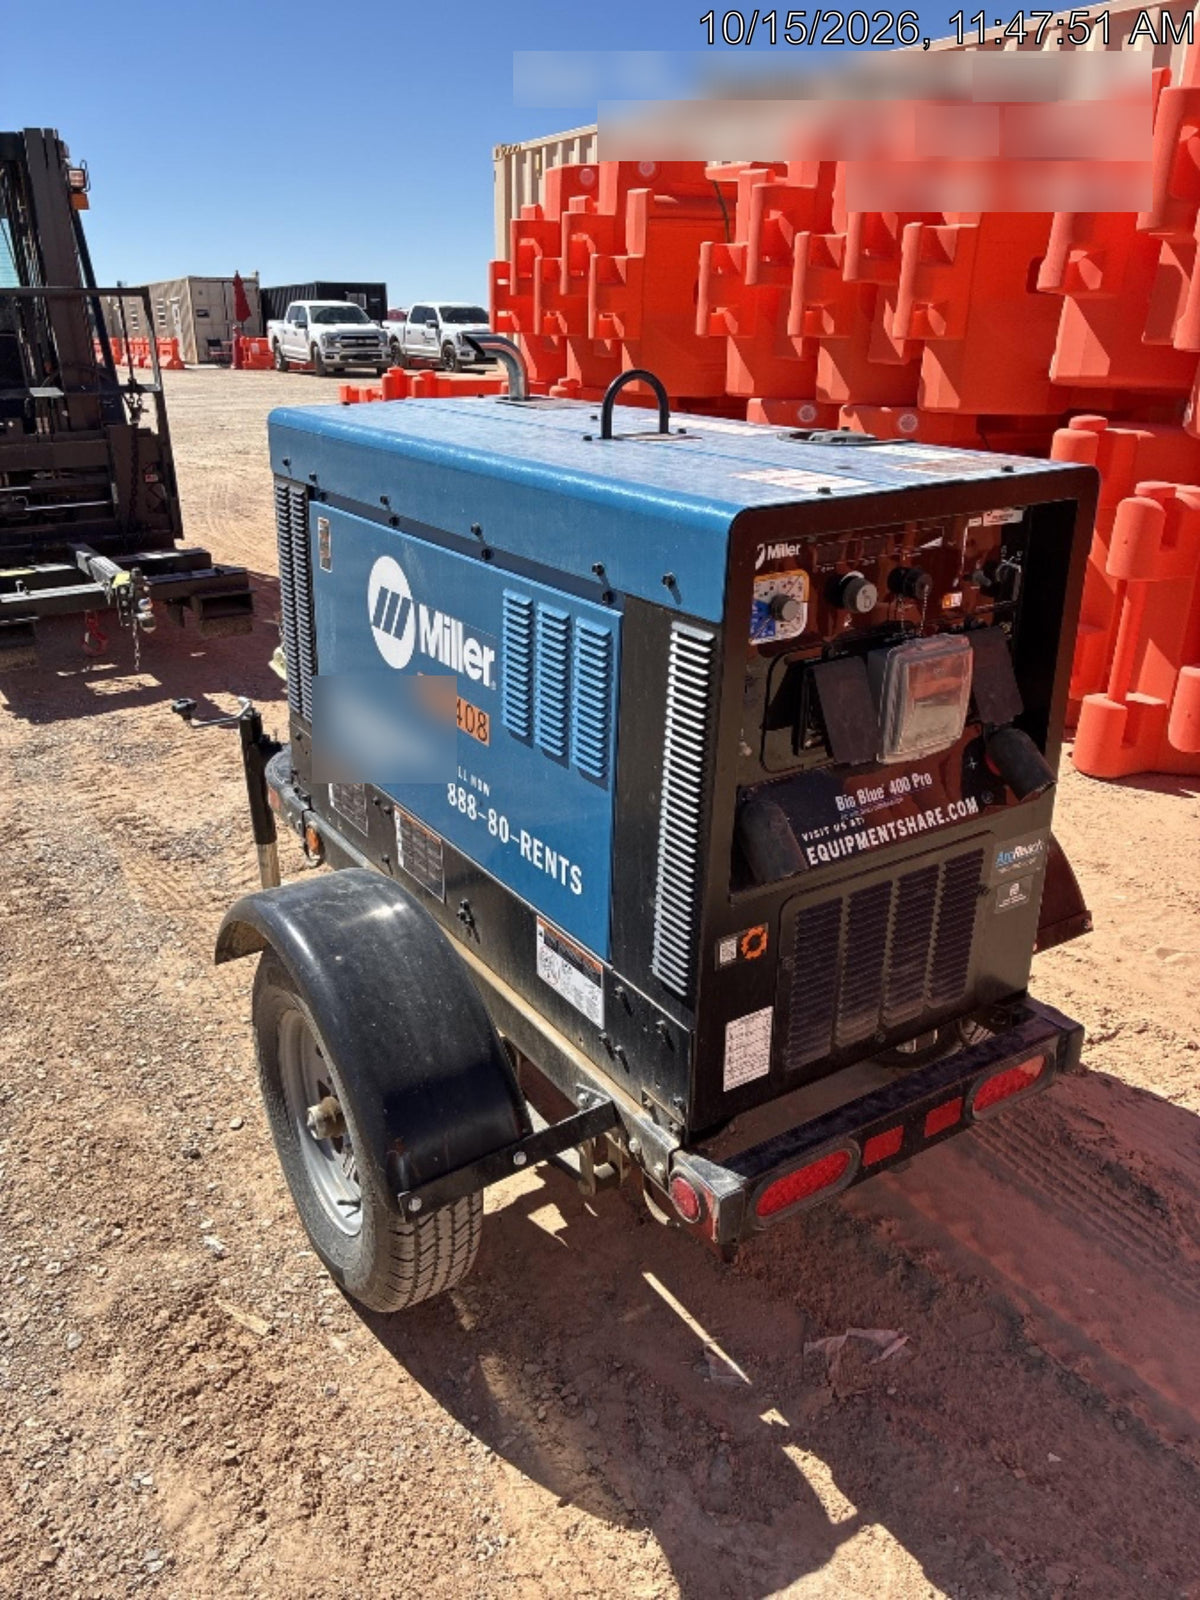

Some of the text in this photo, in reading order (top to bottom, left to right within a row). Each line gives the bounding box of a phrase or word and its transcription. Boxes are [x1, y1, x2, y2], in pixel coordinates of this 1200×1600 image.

[767, 542, 801, 561] Miller
[419, 602, 496, 689] Miller
[835, 794, 856, 812] Big
[889, 777, 912, 796] 400
[911, 772, 933, 788] Pro
[447, 782, 583, 895] 888-80-RENTS
[801, 825, 830, 842] VISIT
[833, 819, 847, 833] US
[806, 796, 979, 866] EQUIPMENTSHARE.COM
